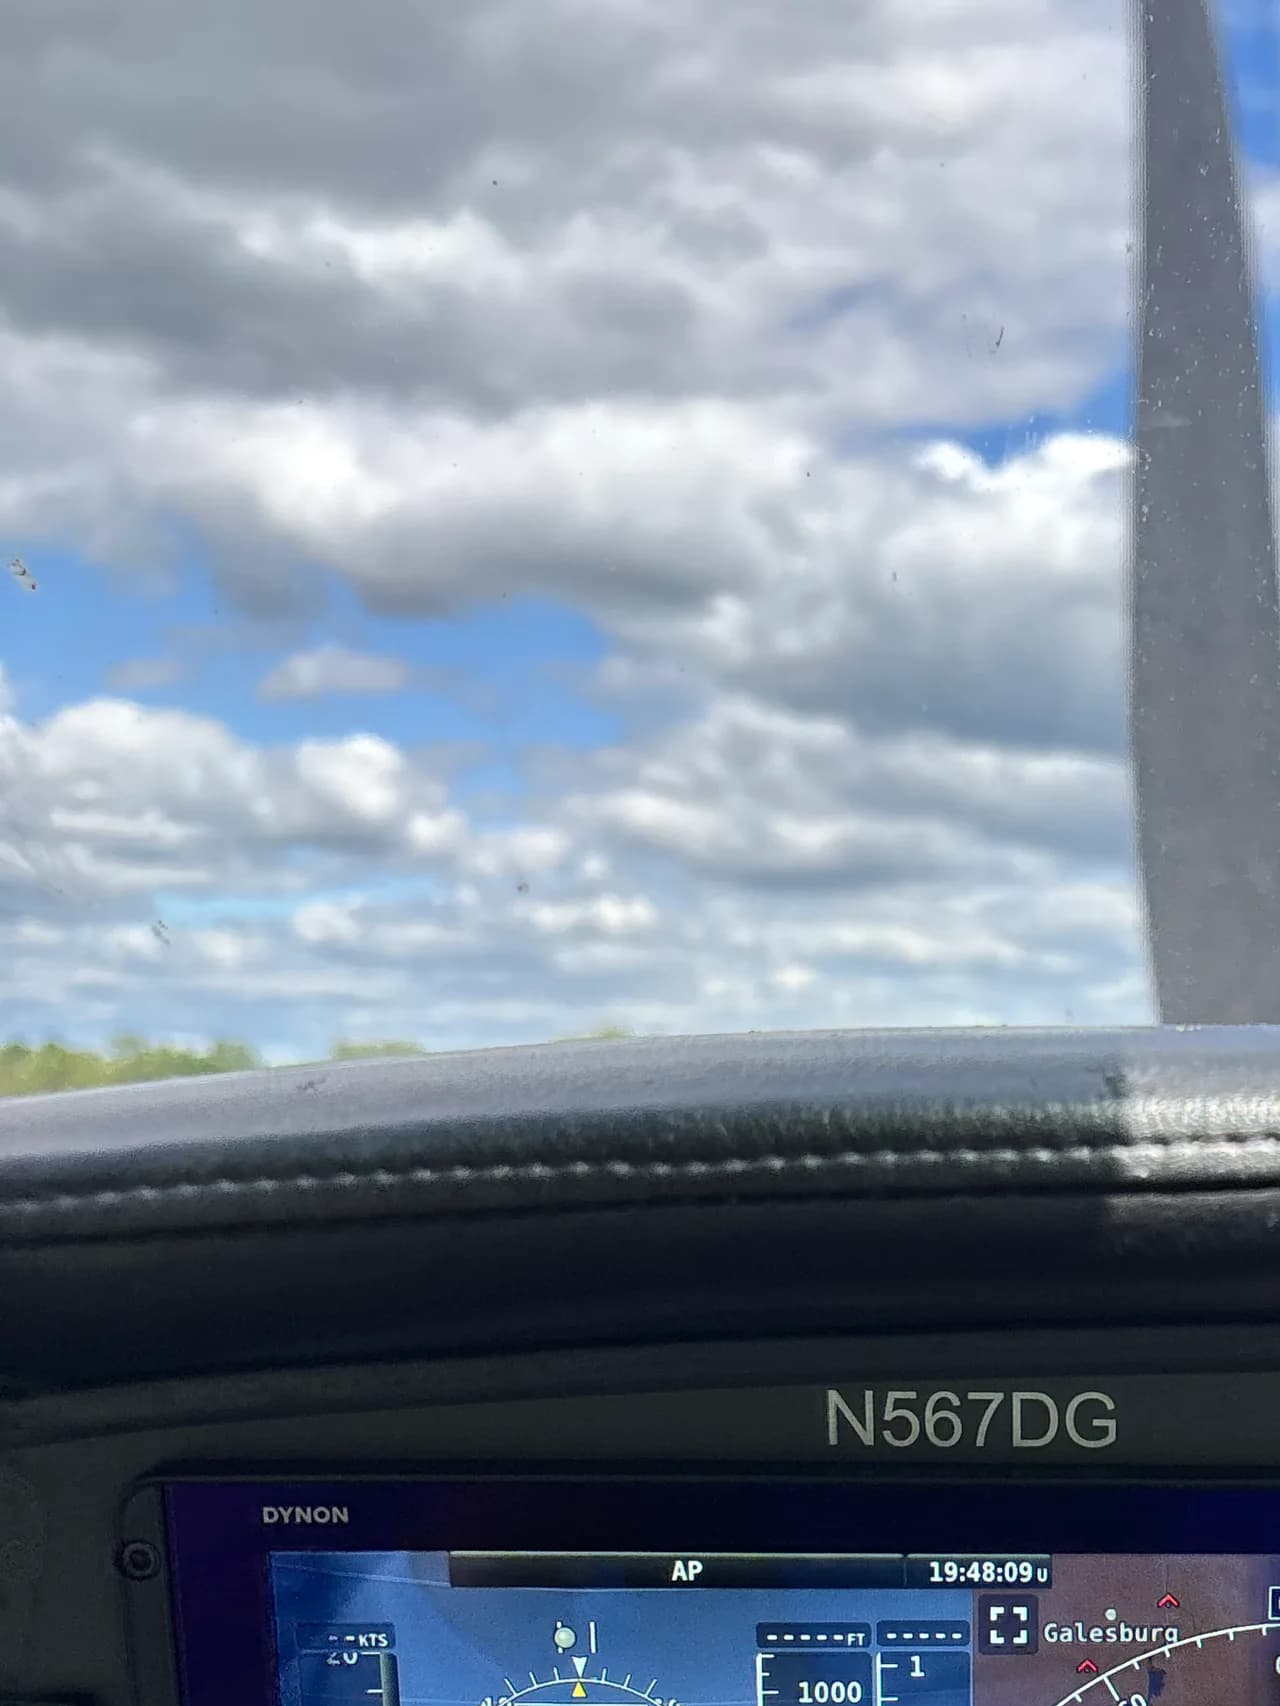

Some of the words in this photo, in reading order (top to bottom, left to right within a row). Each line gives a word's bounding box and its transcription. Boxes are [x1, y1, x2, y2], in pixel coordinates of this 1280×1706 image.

[826, 1388, 1118, 1449] N567DG
[262, 1506, 349, 1525] DYNON
[672, 1560, 703, 1582] AP
[929, 1561, 1032, 1583] 19:48:09
[358, 1631, 389, 1648] KTS
[848, 1633, 865, 1646] FT
[799, 1682, 861, 1703] 1000
